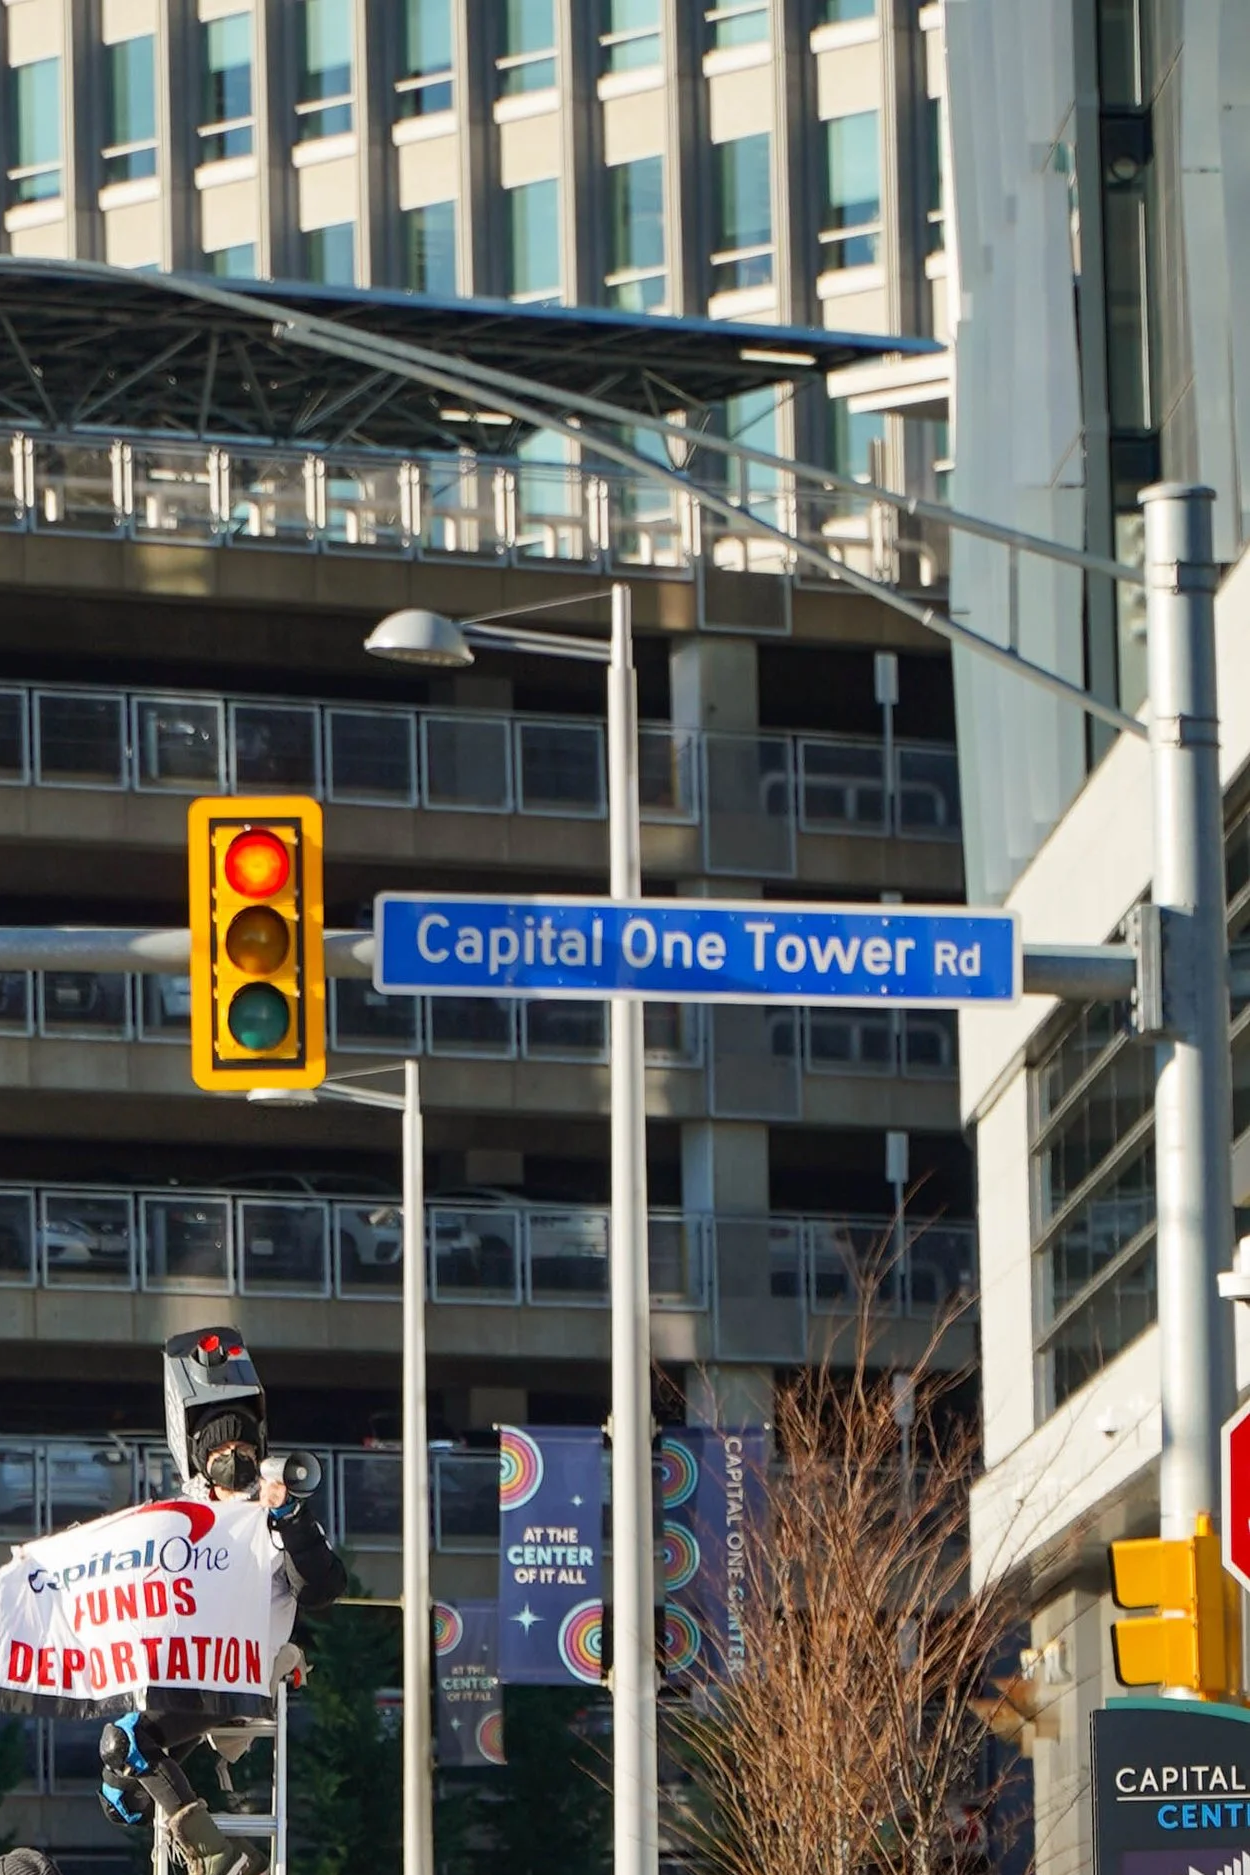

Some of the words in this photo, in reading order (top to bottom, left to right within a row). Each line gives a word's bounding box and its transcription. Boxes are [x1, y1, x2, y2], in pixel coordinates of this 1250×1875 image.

[417, 914, 603, 975] Capital
[622, 917, 726, 970] One
[745, 922, 915, 976] Tower
[935, 943, 982, 977] Rd
[724, 1436, 743, 1528] CAPITAL
[523, 1526, 544, 1544] AT
[546, 1527, 578, 1544] THE
[507, 1545, 594, 1567] CENTER
[726, 1531, 745, 1580] ONE
[514, 1568, 537, 1585] OF
[540, 1568, 555, 1585] IT
[557, 1568, 587, 1585] ALL
[8, 1635, 262, 1690] DEPORTATION
[1115, 1766, 1246, 1793] CAPITAL
[1158, 1803, 1250, 1829] CENT
